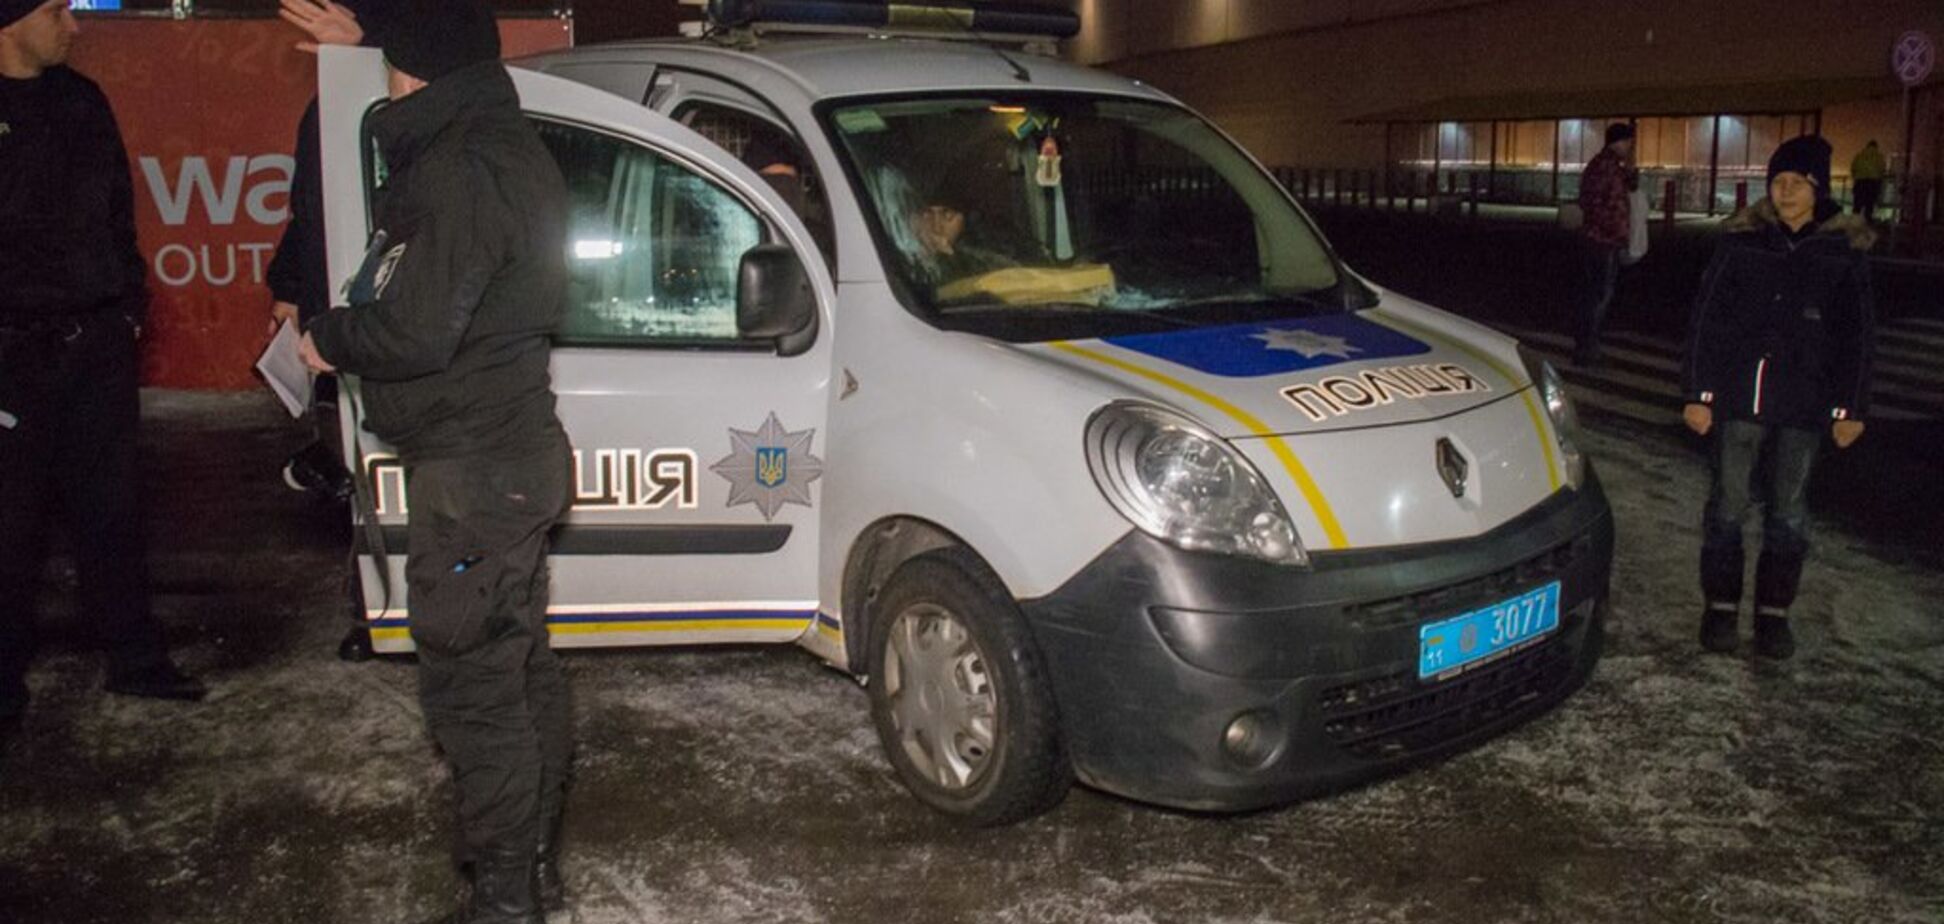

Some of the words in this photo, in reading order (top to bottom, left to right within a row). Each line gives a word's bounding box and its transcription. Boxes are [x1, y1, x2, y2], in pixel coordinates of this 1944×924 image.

[155, 243, 274, 286] OUT
[1280, 363, 1493, 422] ПОЛІЦІЯ
[363, 447, 698, 515] ПЦІЯ
[1491, 592, 1548, 646] 3077
